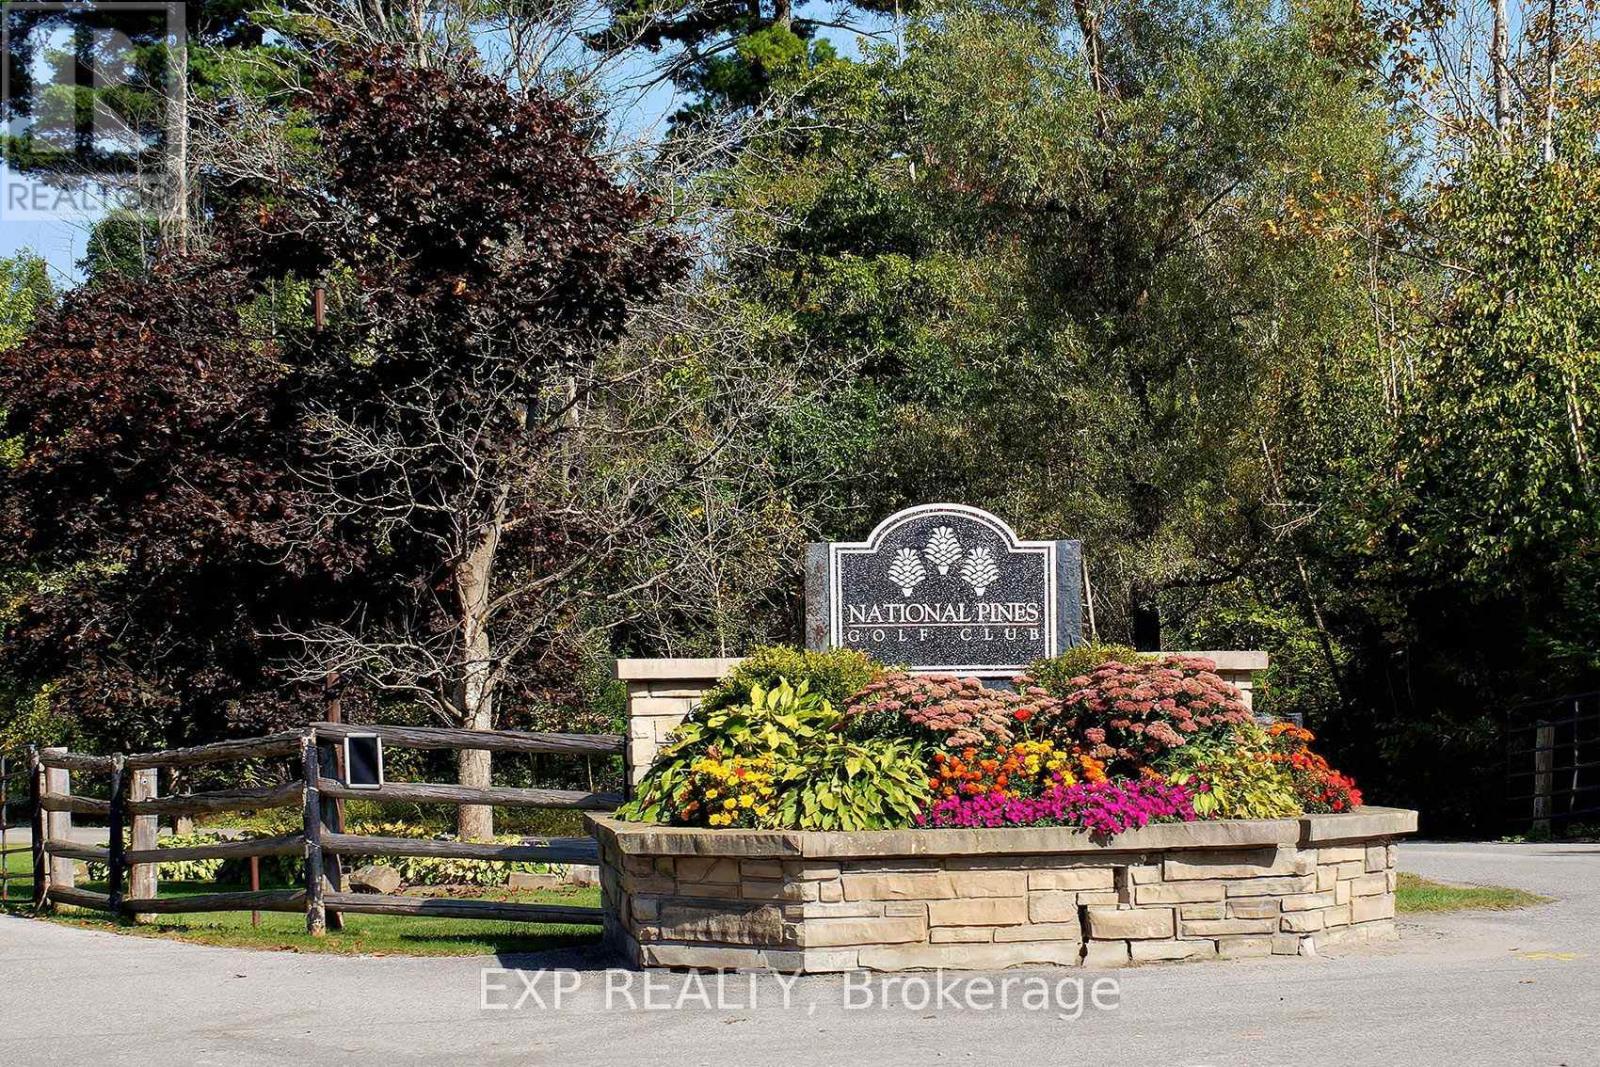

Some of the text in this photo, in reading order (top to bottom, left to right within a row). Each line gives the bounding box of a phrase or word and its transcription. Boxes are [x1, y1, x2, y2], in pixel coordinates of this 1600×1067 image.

[847, 602, 1039, 623] NATIONAL PINES
[847, 628, 1039, 642] GOLF CLUB
